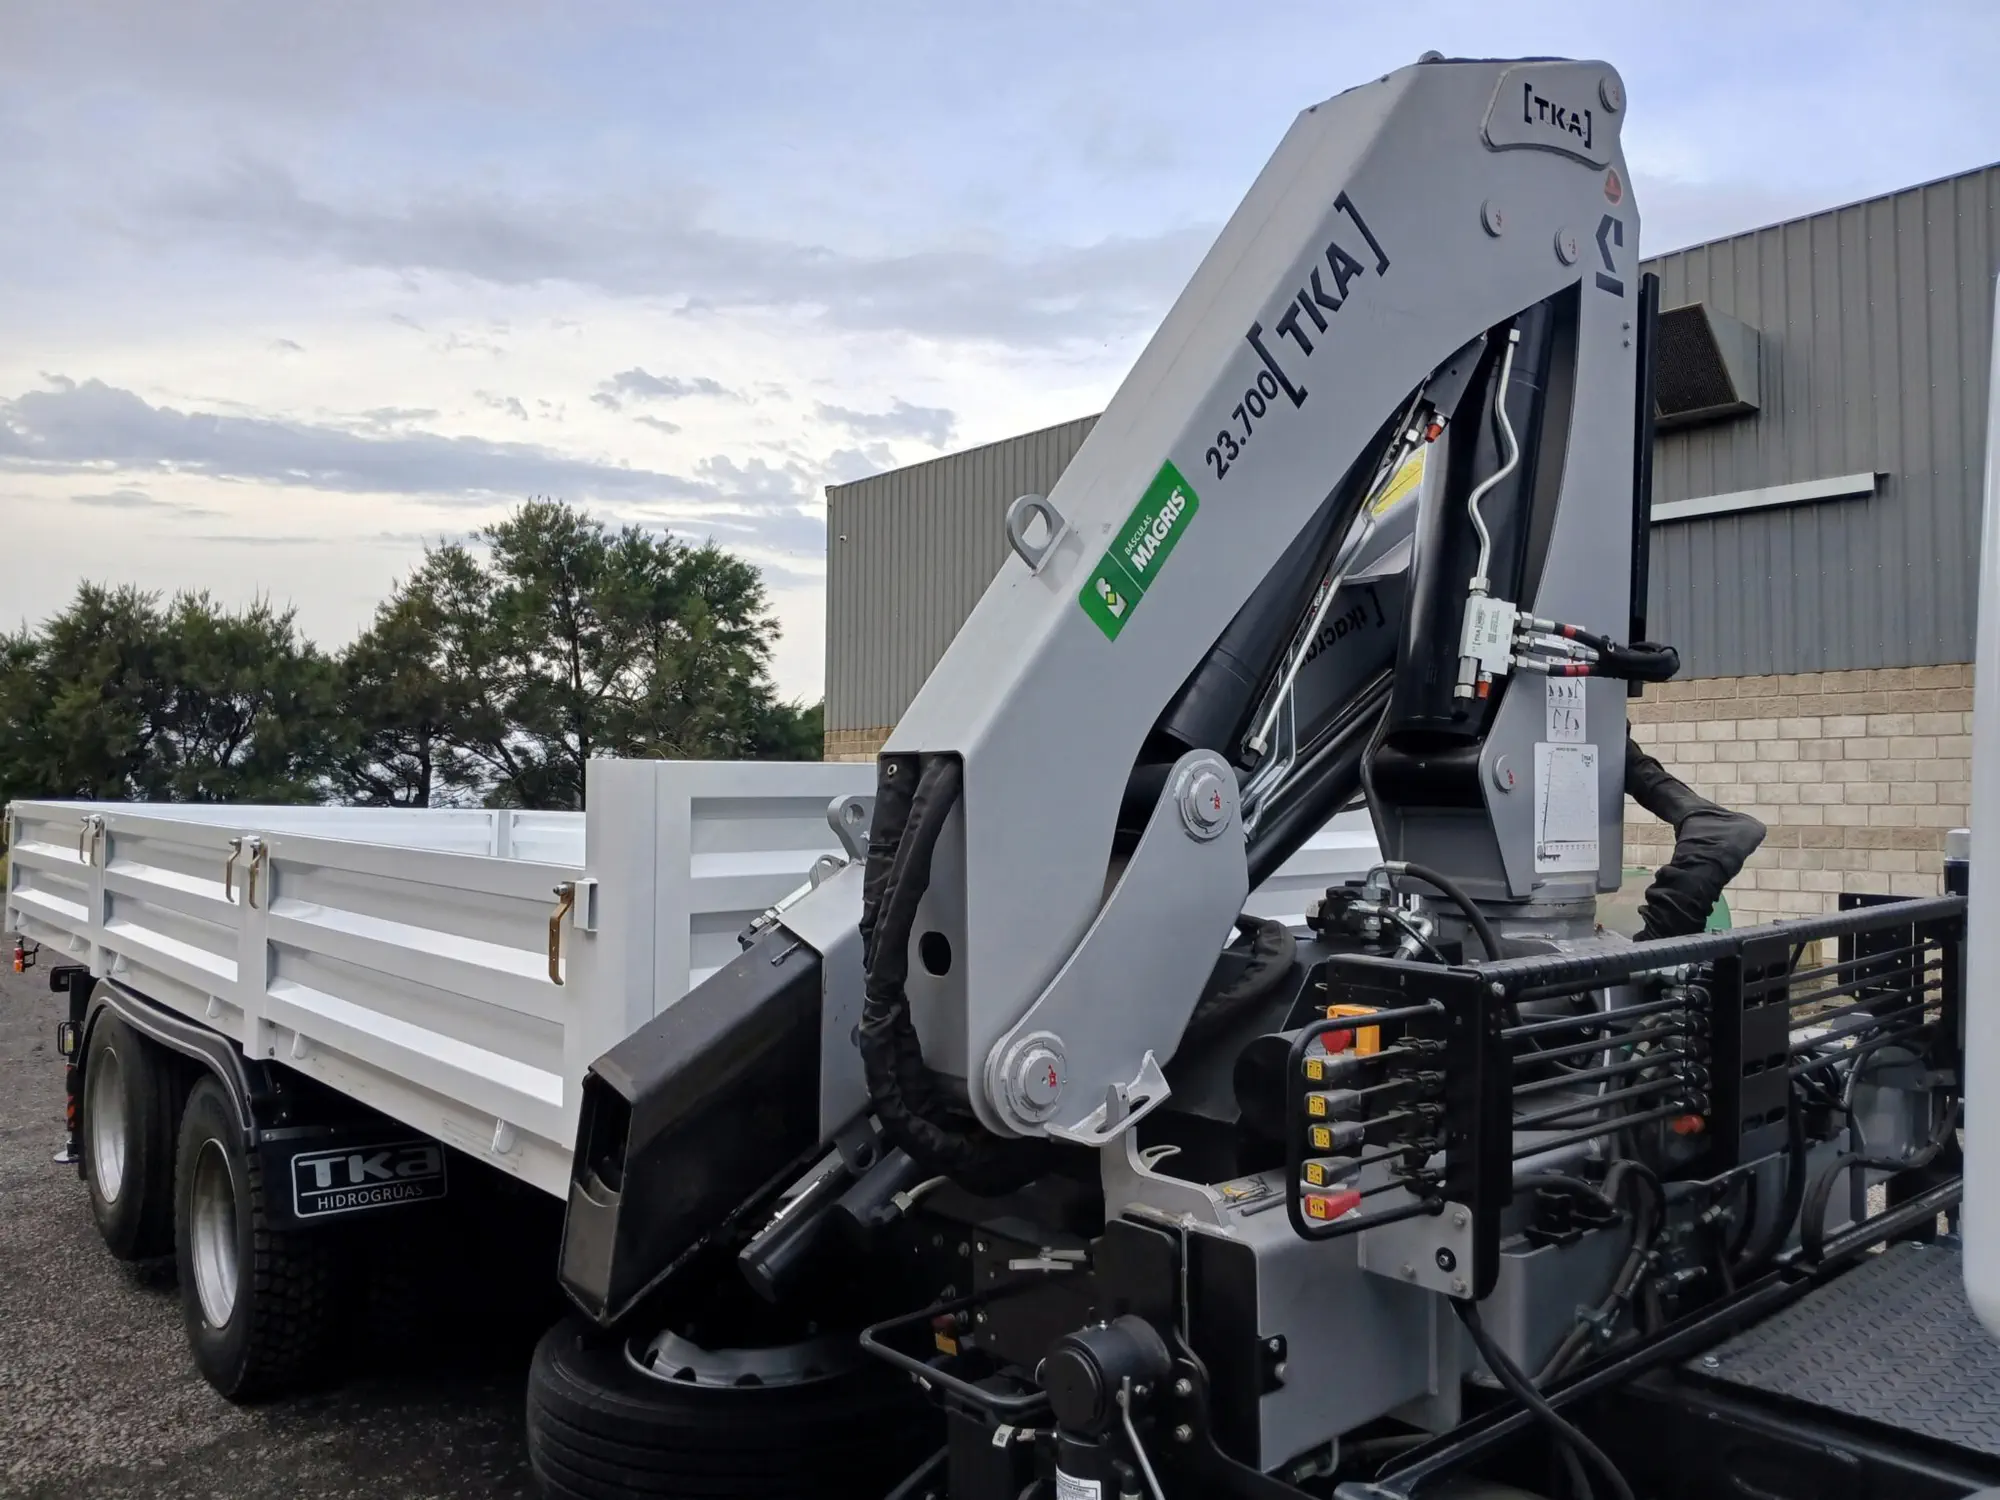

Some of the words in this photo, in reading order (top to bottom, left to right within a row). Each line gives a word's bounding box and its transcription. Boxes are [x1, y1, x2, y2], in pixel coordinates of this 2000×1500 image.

[1206, 369, 1279, 480] 23.700
[1131, 489, 1186, 573] MAGRIS
[317, 1183, 424, 1211] HIDROGRÚAS
